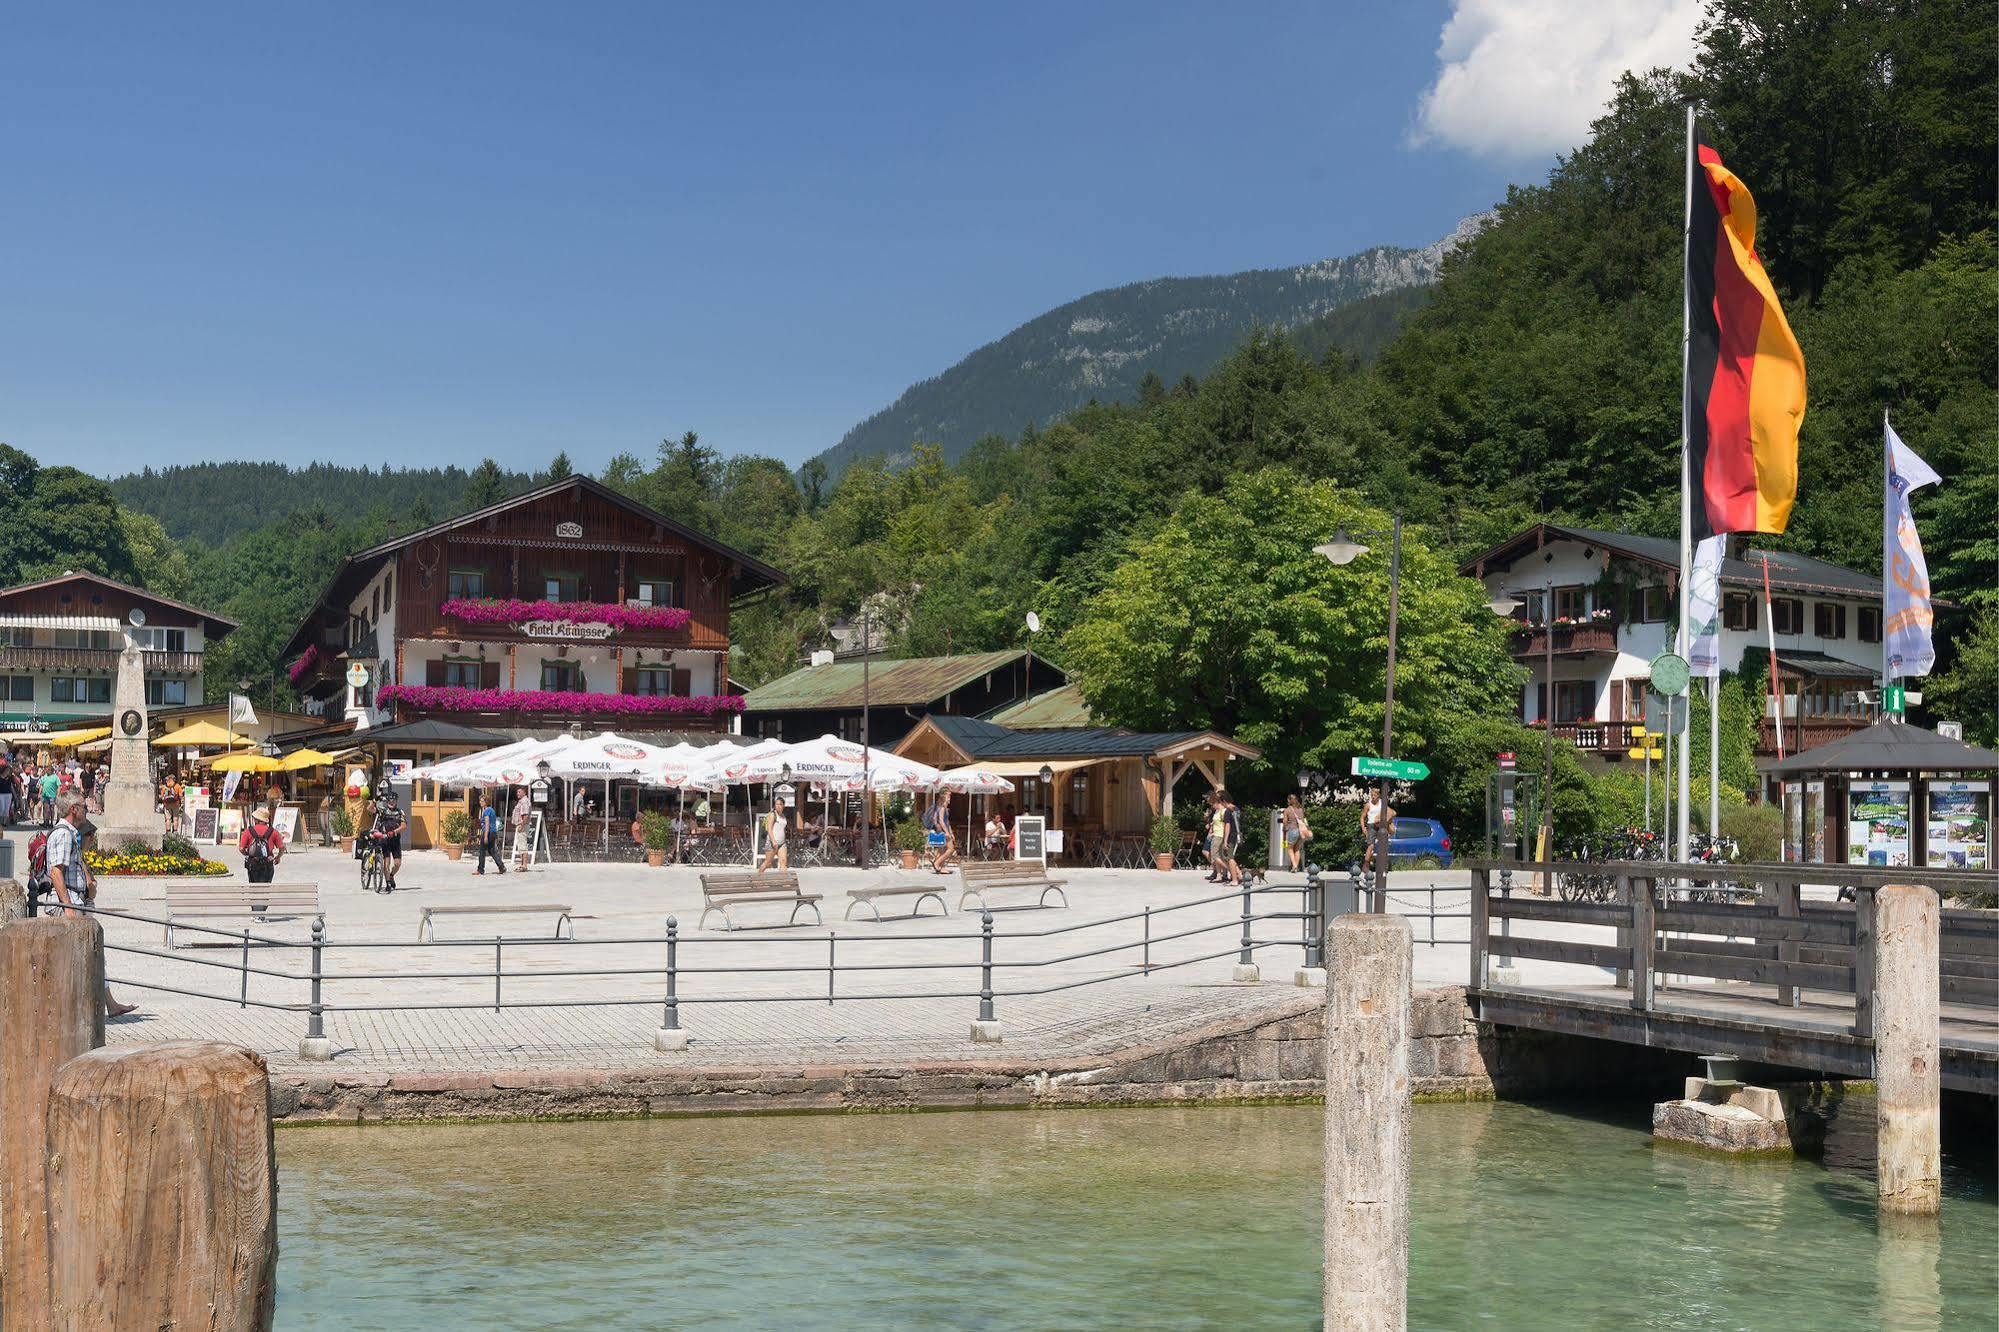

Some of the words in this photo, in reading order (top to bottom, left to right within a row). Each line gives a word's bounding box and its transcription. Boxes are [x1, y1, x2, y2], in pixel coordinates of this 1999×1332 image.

[559, 524, 580, 536] 1862
[529, 623, 553, 636] Hotel
[573, 761, 611, 771] ERDINGER
[797, 762, 836, 773] ERDINGER
